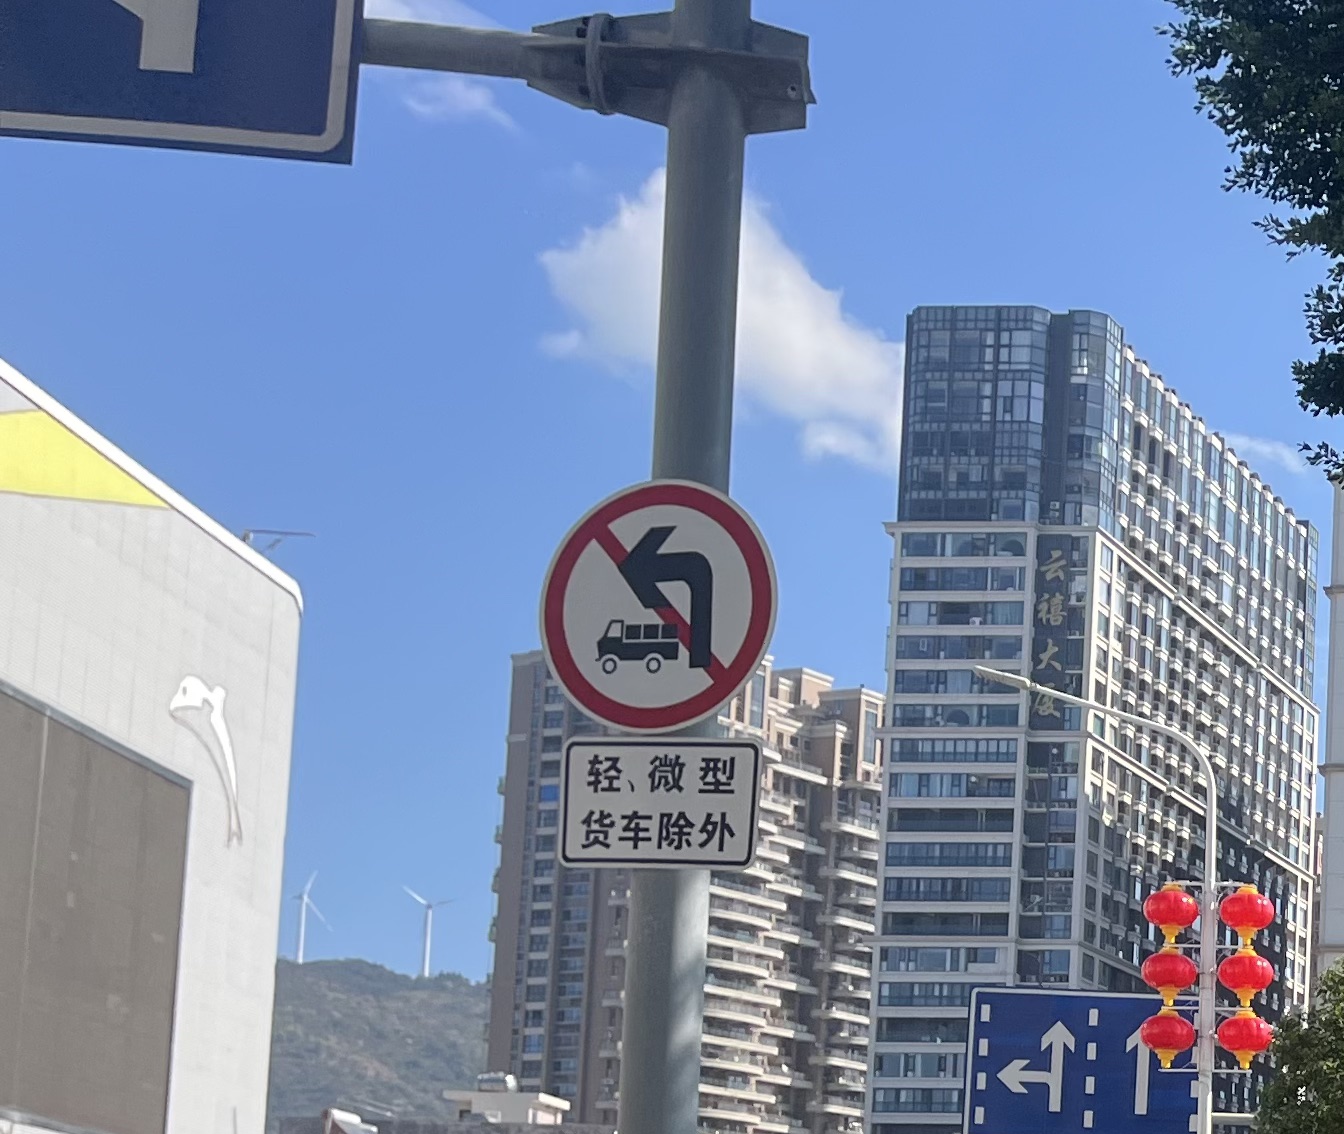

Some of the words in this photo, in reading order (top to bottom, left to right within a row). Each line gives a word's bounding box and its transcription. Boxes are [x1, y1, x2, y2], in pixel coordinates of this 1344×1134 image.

[586, 753, 737, 795] 轻、微型
[580, 809, 737, 852] 货车除外
